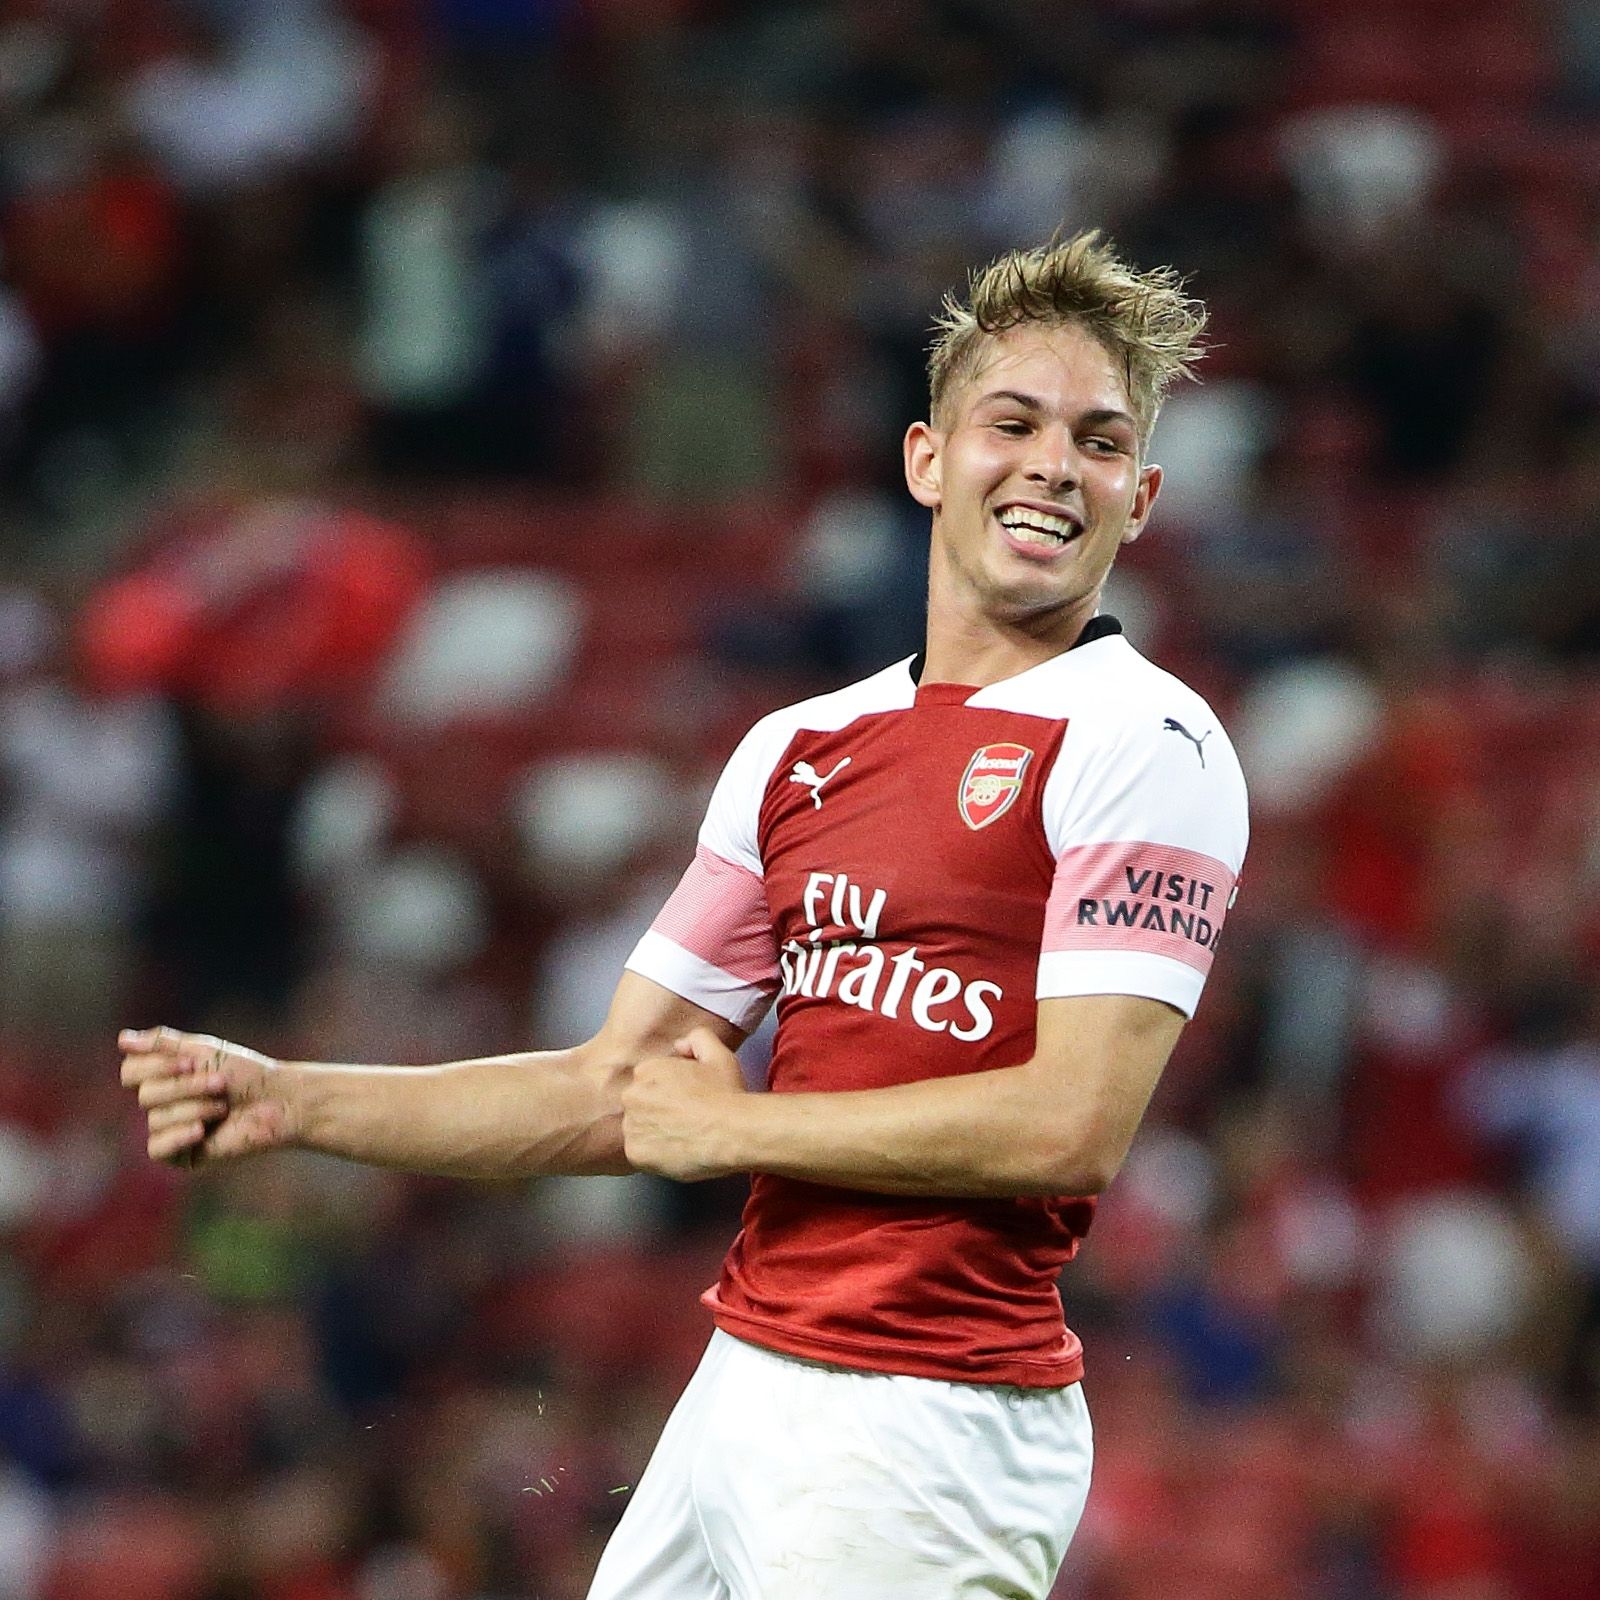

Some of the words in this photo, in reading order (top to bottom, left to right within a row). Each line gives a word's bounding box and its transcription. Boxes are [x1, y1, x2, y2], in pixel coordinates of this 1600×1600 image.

[976, 756, 1022, 769] Arsenal
[803, 872, 888, 939] Fly
[1125, 866, 1215, 911] VISIT
